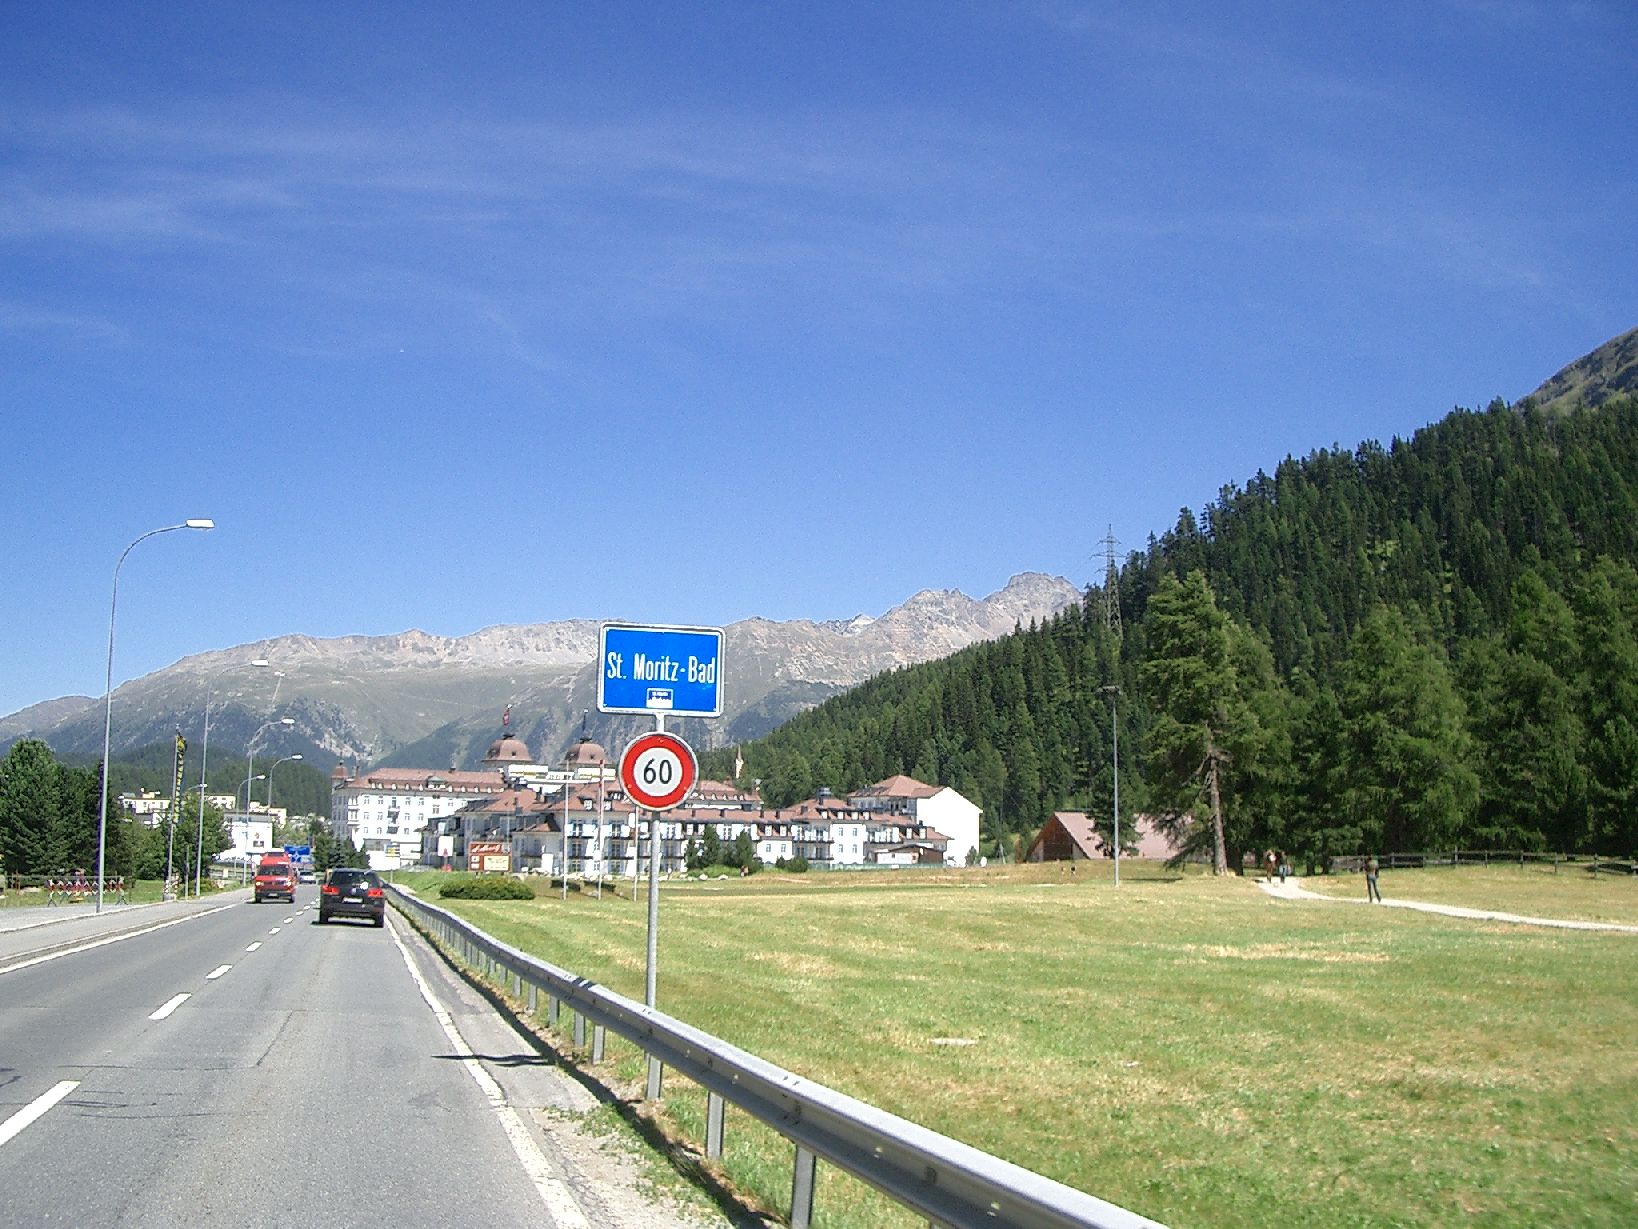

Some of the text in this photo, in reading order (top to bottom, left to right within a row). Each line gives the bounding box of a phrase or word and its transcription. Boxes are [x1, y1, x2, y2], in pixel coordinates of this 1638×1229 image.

[607, 651, 716, 684] St. Moritz-Bad
[643, 757, 672, 784] 60
